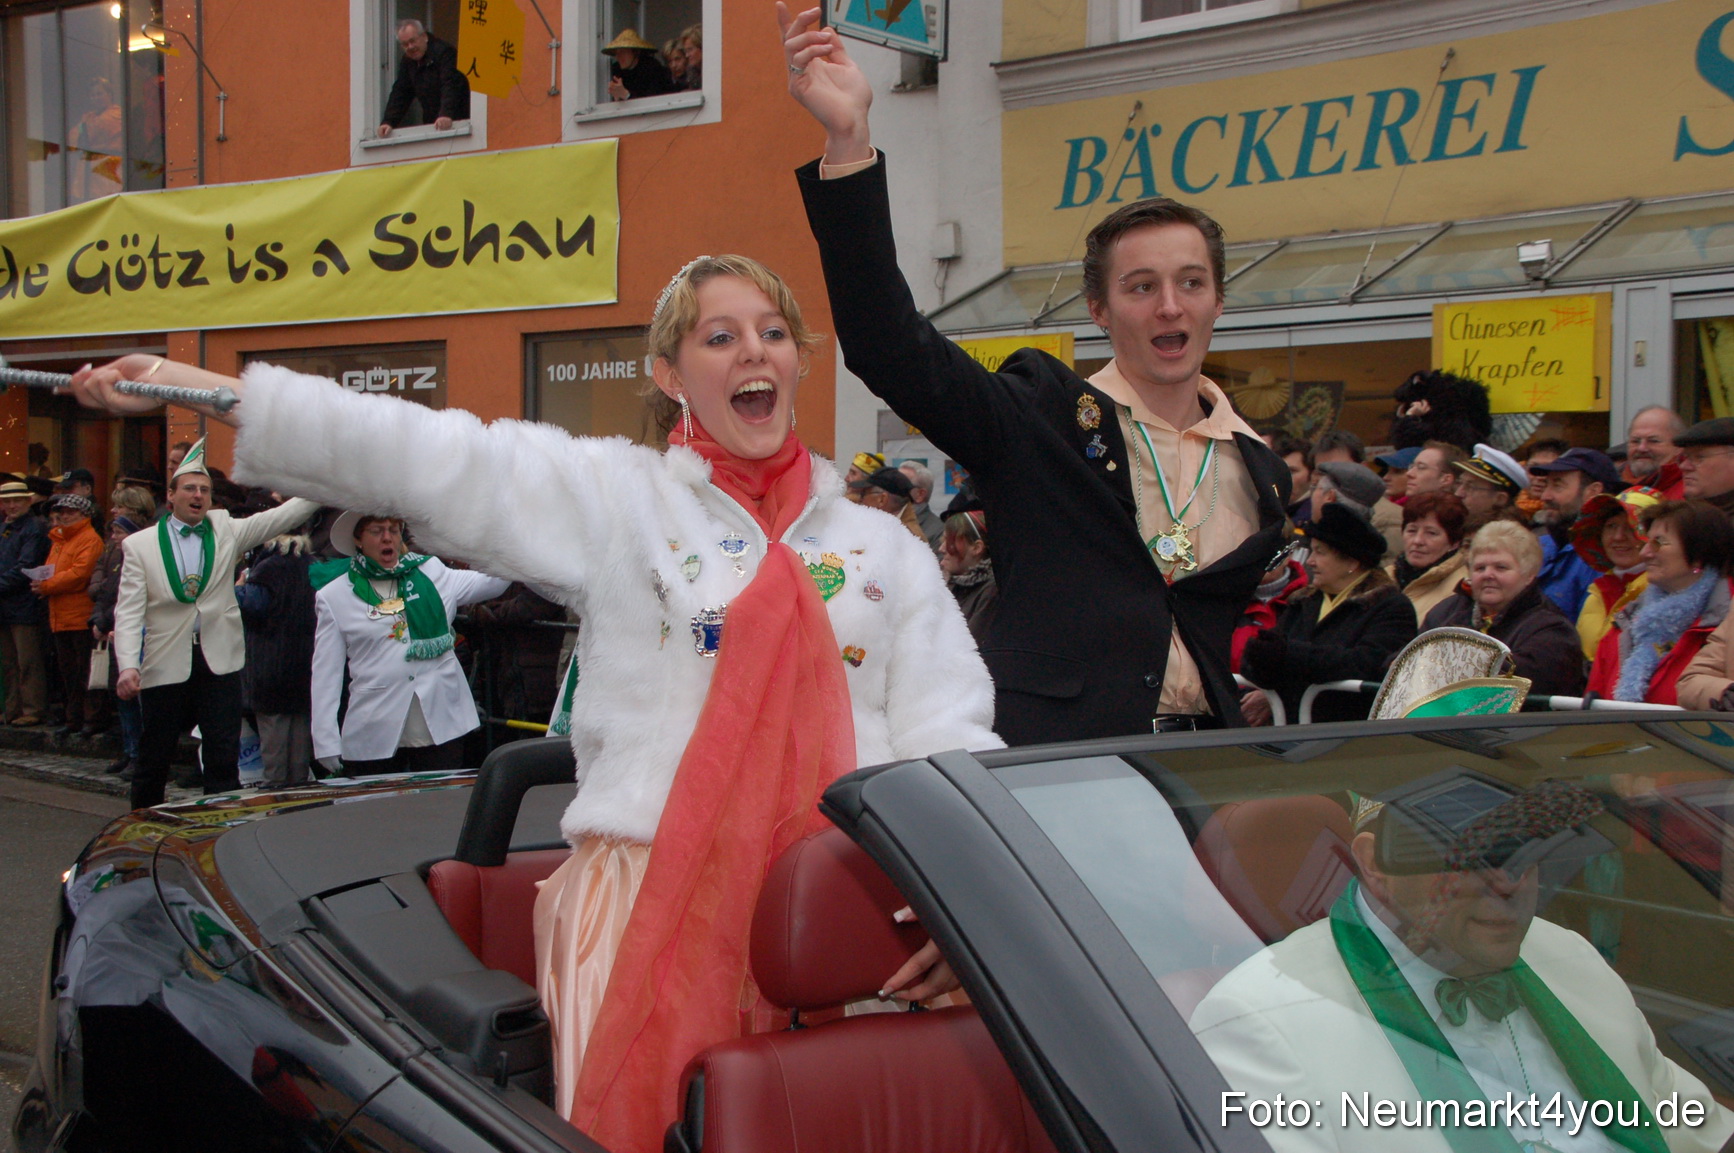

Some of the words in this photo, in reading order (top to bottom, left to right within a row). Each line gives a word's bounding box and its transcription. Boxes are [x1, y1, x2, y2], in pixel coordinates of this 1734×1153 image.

[1054, 64, 1546, 211] BÄCKEREI
[66, 233, 210, 297] Götz
[225, 223, 289, 284] is
[368, 198, 596, 272] Schau
[1450, 311, 1546, 341] Chinesen
[342, 366, 437, 393] GÖTZ
[547, 363, 577, 382] 100
[581, 360, 637, 381] JAHRE
[1461, 346, 1564, 386] Krapfen
